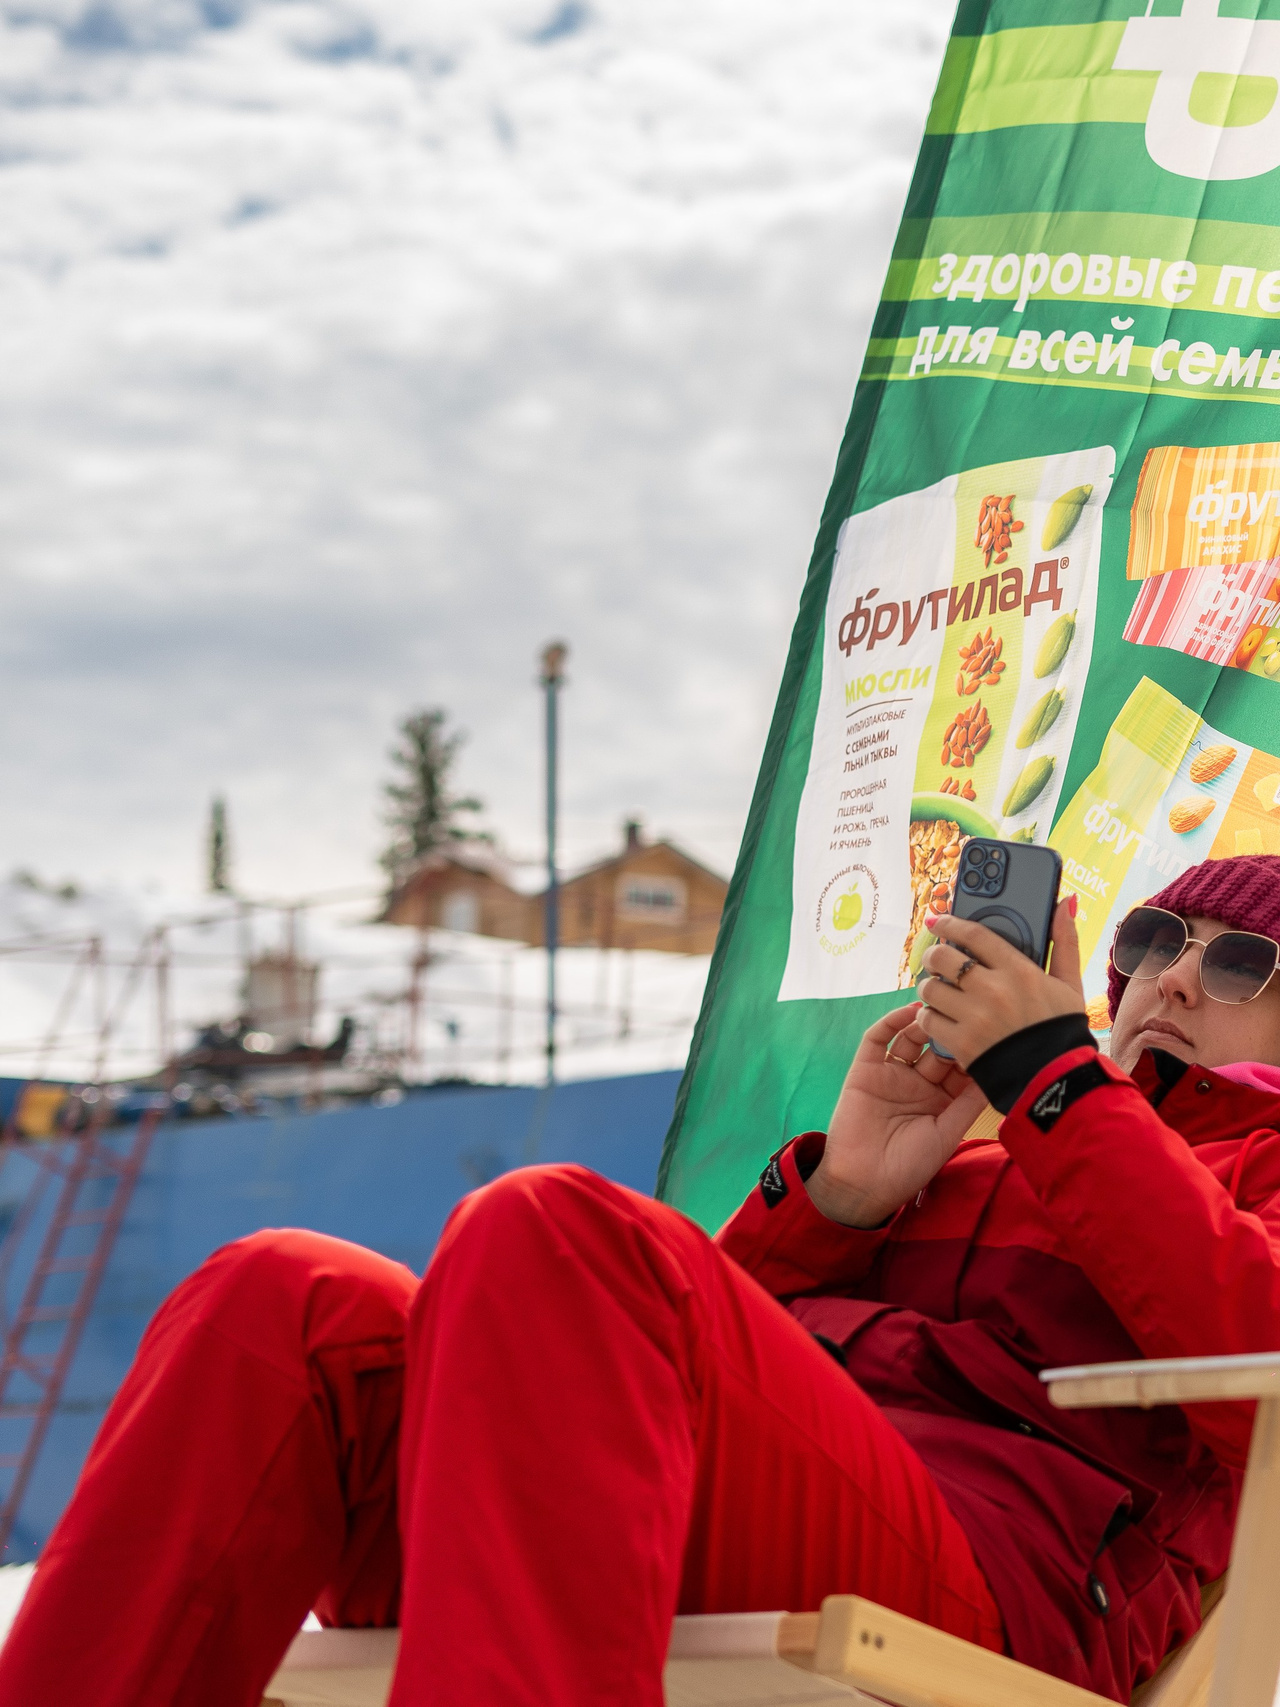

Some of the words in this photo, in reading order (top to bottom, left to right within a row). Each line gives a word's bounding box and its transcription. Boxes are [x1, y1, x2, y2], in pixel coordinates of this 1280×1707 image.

[932, 252, 1197, 312] здоровые
[908, 325, 994, 378] для
[1008, 315, 1136, 378] всей
[1202, 544, 1243, 556] АРАХИС
[845, 743, 851, 756] С
[851, 729, 890, 754] СЕМЕНАМИ
[843, 758, 864, 773] ЛЬНА
[870, 744, 898, 761] ТЫКВЫ
[837, 802, 875, 818] ПШЕНИЦА
[833, 824, 842, 834] И
[1083, 800, 1191, 878] фрутил
[829, 841, 838, 851] И
[838, 837, 872, 850] ЯЧМЕНЬ
[868, 893, 880, 928] СОКОМ
